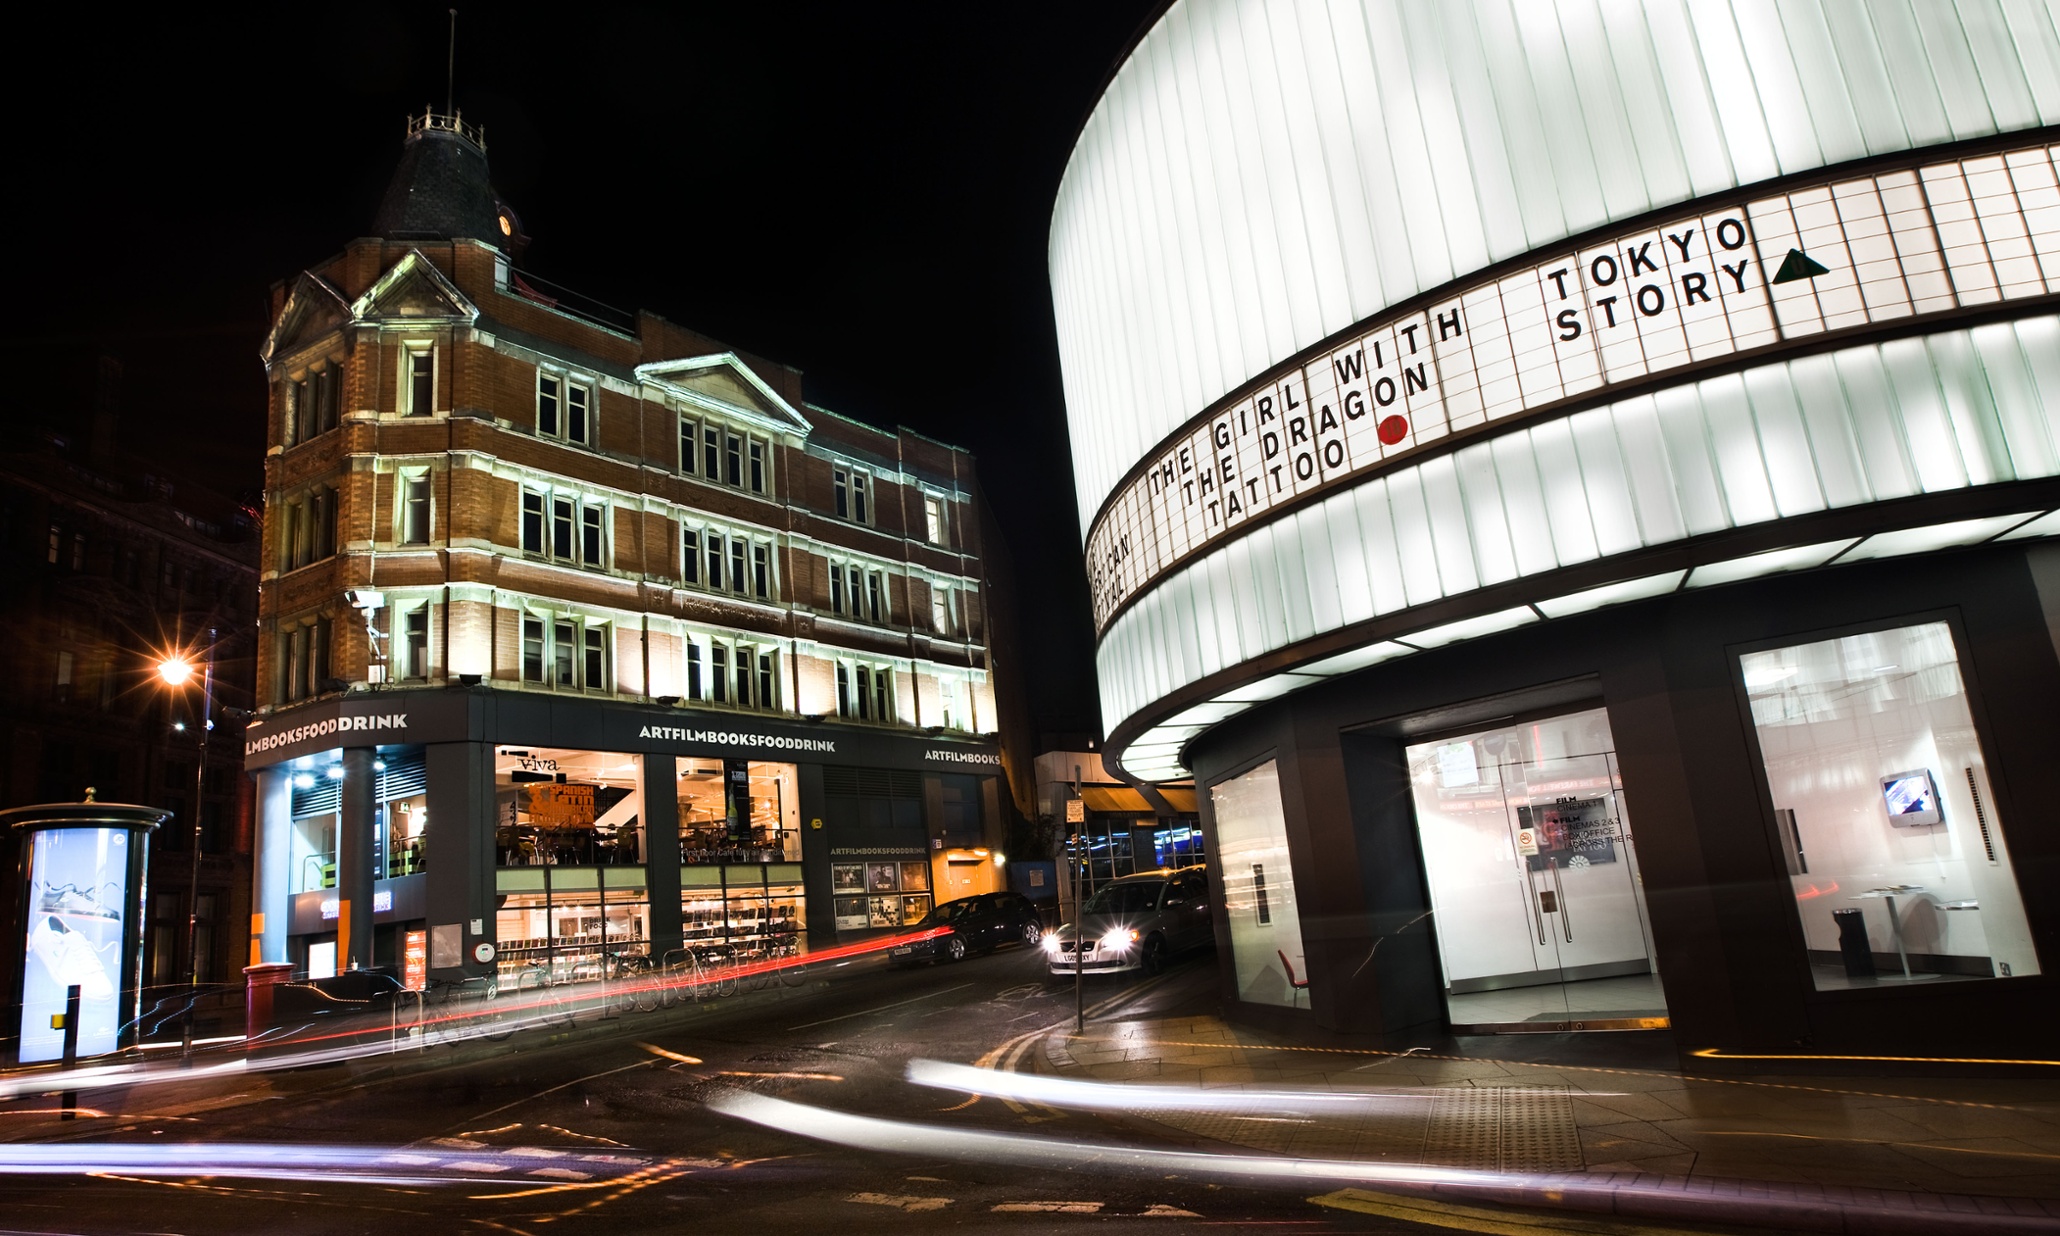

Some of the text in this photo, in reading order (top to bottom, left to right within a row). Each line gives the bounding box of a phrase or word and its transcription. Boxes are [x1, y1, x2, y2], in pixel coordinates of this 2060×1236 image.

[1548, 218, 1746, 300] TOKYO
[1556, 259, 1749, 341] STORY
[1151, 309, 1463, 496] THE GIRL WITH
[1183, 363, 1428, 506] THE DRAGON
[1208, 439, 1344, 527] TATTOO
[639, 726, 835, 752] ARTFILMBOOKSFOODDRINK
[925, 750, 1000, 765] ARTFILMBOOKS
[549, 785, 594, 795] SPANISH
[1556, 796, 1577, 804] FILM
[1557, 803, 1591, 812] CINEMA
[1560, 815, 1580, 823] FILM
[1561, 820, 1600, 831] CINEMAS
[1562, 827, 1615, 841] BOX OFFICE
[1607, 835, 1624, 844] THE
[830, 847, 926, 856] ARTFILMBOOKSFOODDRINK
